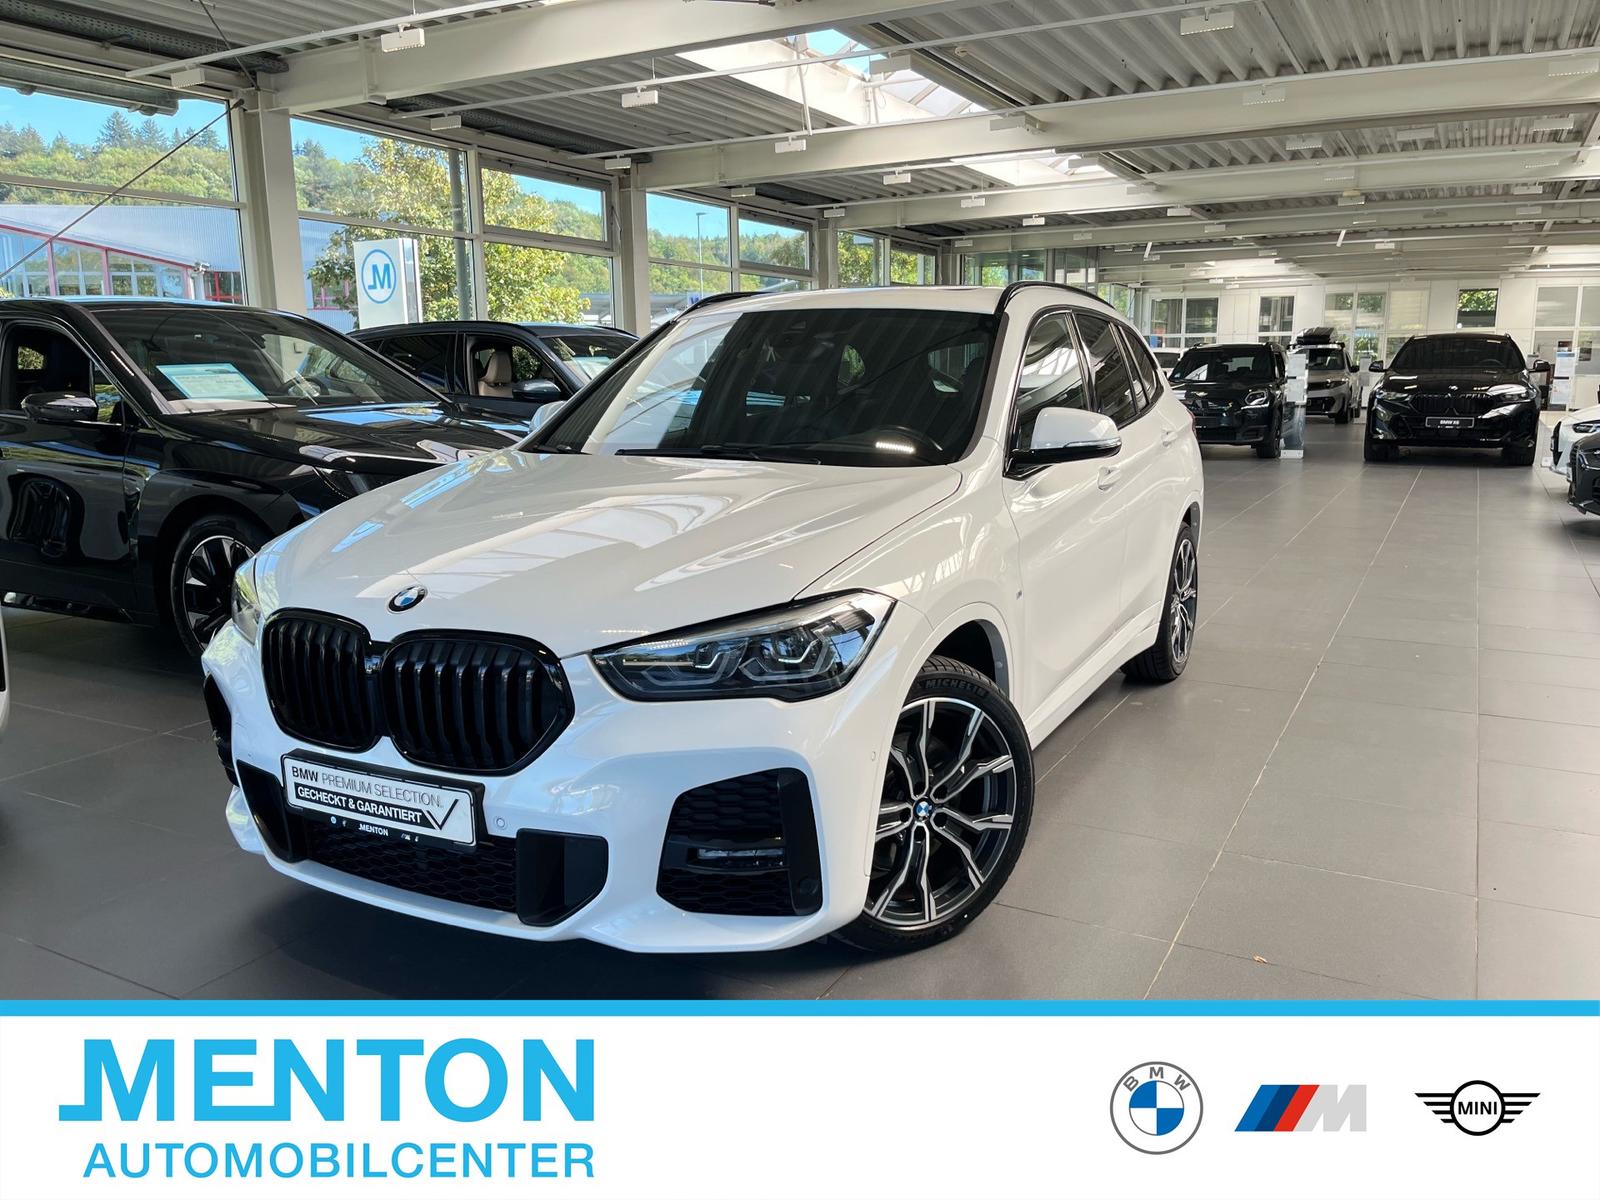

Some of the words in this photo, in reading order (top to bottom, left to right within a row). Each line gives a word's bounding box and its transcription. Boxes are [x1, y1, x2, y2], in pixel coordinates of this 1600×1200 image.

[925, 678, 988, 697] MICHELIN
[292, 766, 318, 783] BMW
[321, 773, 372, 795] PREMIUM
[297, 786, 347, 808] GECHECKT
[348, 798, 356, 809] &
[356, 800, 422, 824] GARANTIERT
[359, 823, 389, 837] MENTON
